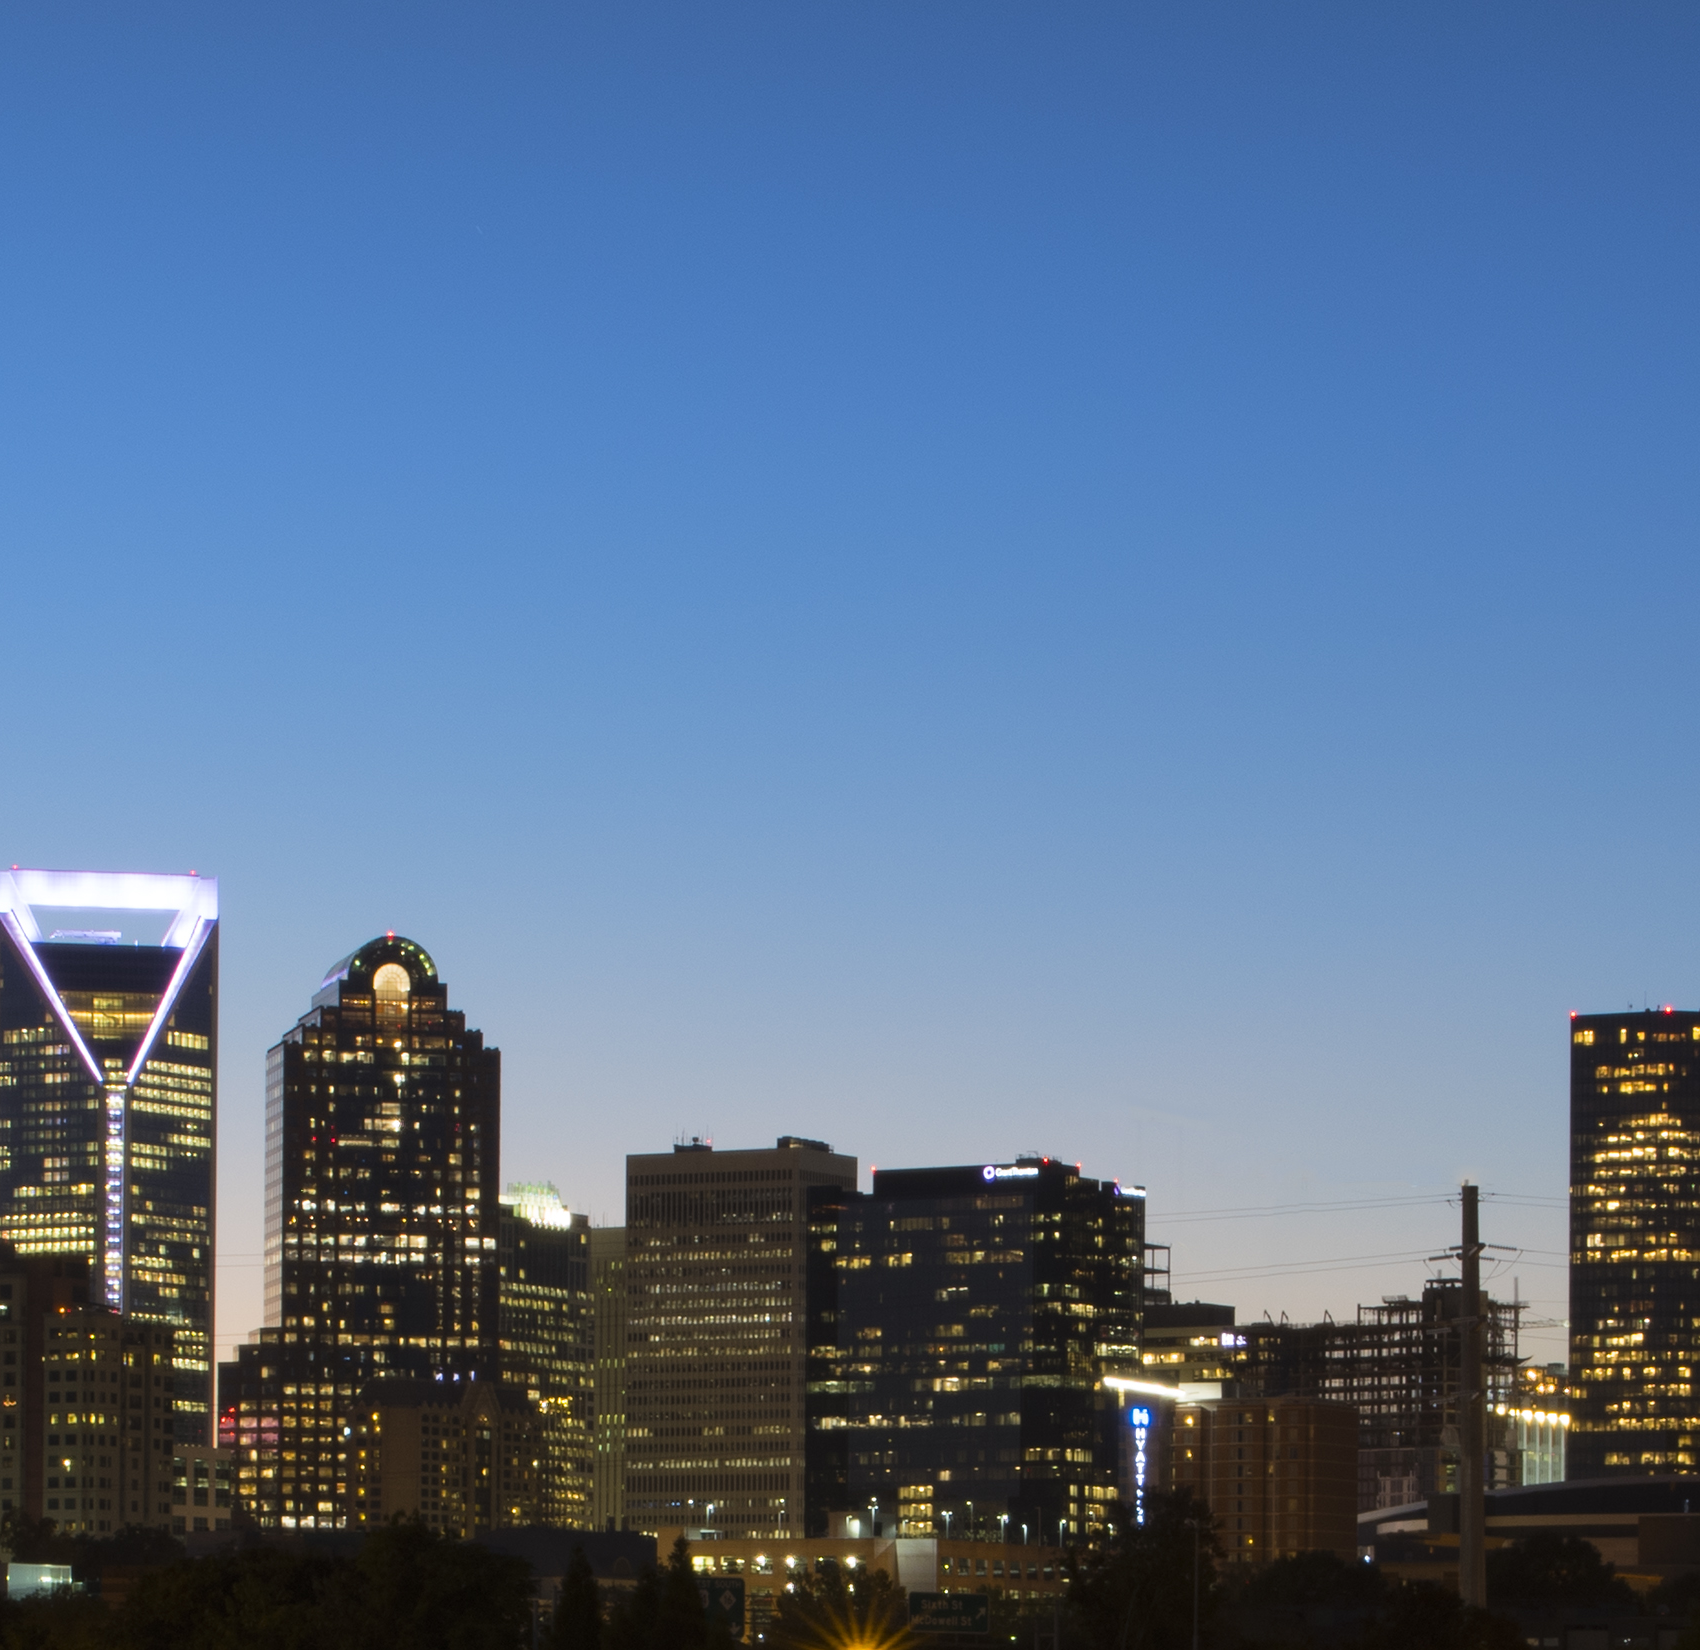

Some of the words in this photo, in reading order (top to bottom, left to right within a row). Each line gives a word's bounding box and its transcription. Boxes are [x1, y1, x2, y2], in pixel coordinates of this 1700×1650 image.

[1135, 1427, 1146, 1486] HYATT
[714, 1580, 742, 1589] SOUTH
[920, 1599, 949, 1610] Sixth
[951, 1600, 963, 1611] St
[911, 1614, 958, 1626] McDowell
[960, 1615, 972, 1627] St
